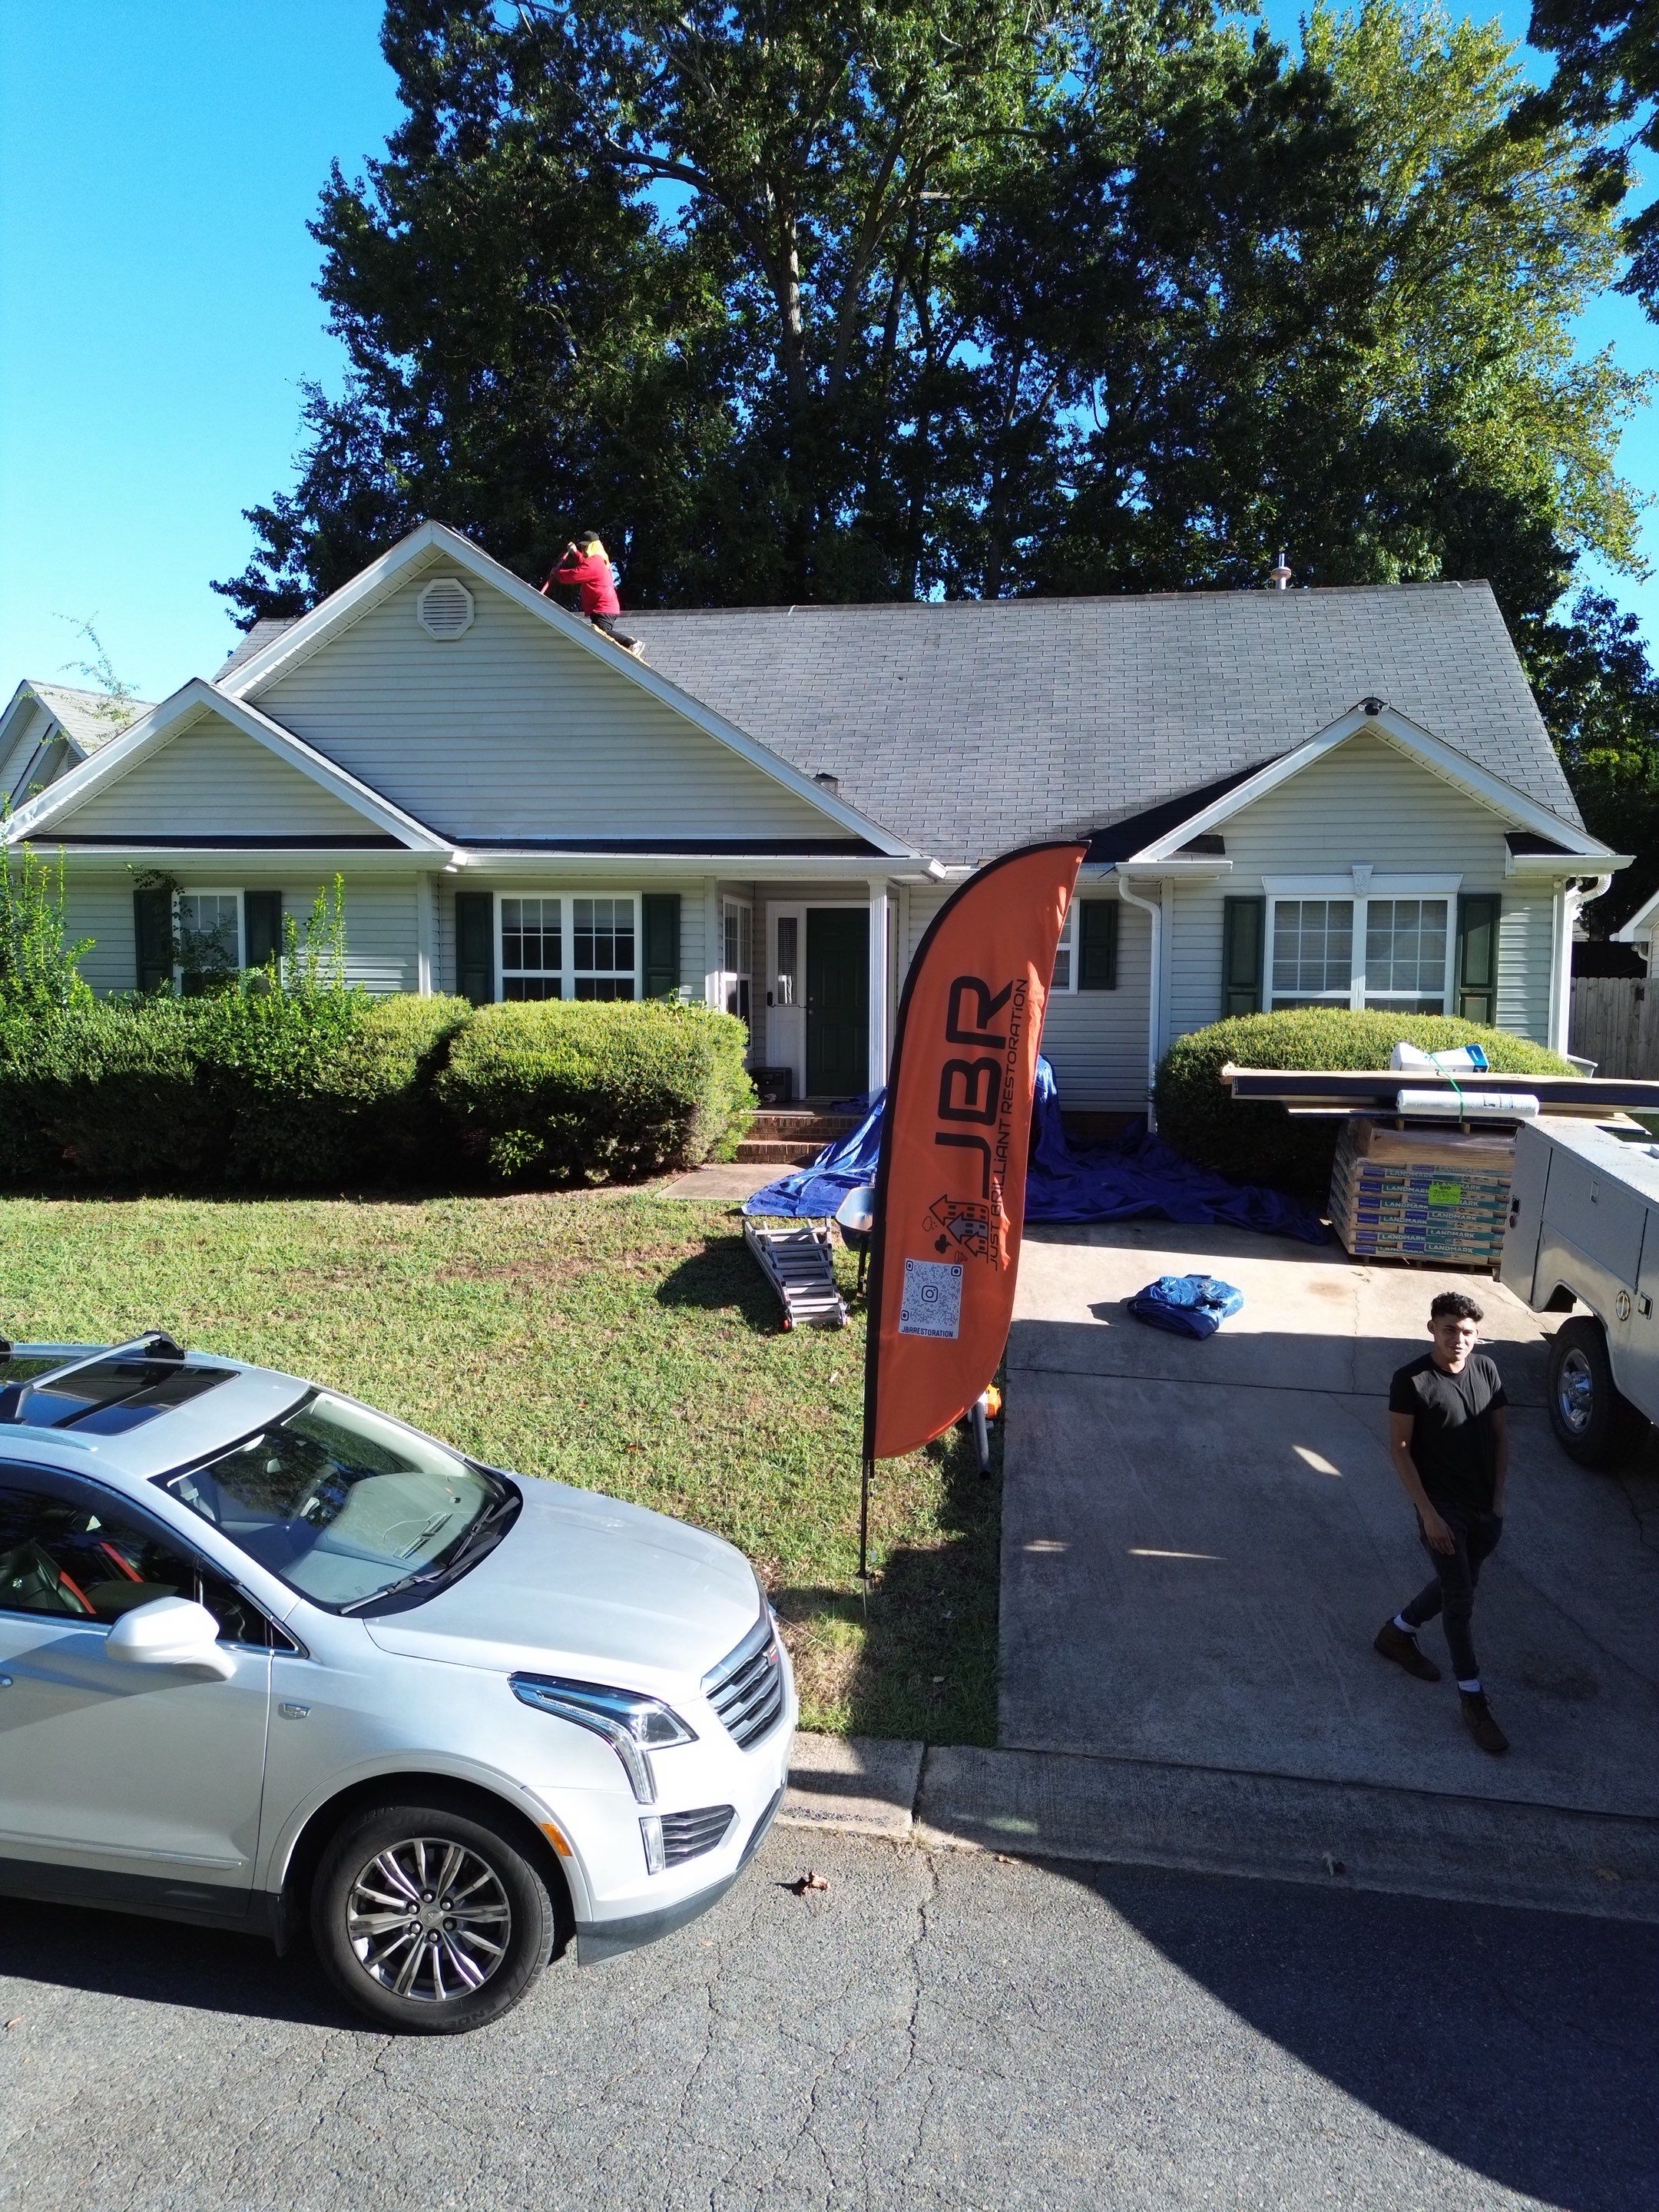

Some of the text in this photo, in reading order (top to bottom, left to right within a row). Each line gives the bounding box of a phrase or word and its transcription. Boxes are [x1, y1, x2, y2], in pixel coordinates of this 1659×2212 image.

[935, 975, 1014, 1200] JBR
[1384, 1201, 1429, 1210] LANDMARK
[1383, 1217, 1428, 1225] LANDMARK
[1432, 1212, 1478, 1221] LANDMARK
[1430, 1230, 1475, 1239] LANDMARK
[989, 1223, 999, 1271] JUST
[1429, 1244, 1474, 1253] LANDMARK
[901, 1326, 954, 1338] JBRRESTORATION
